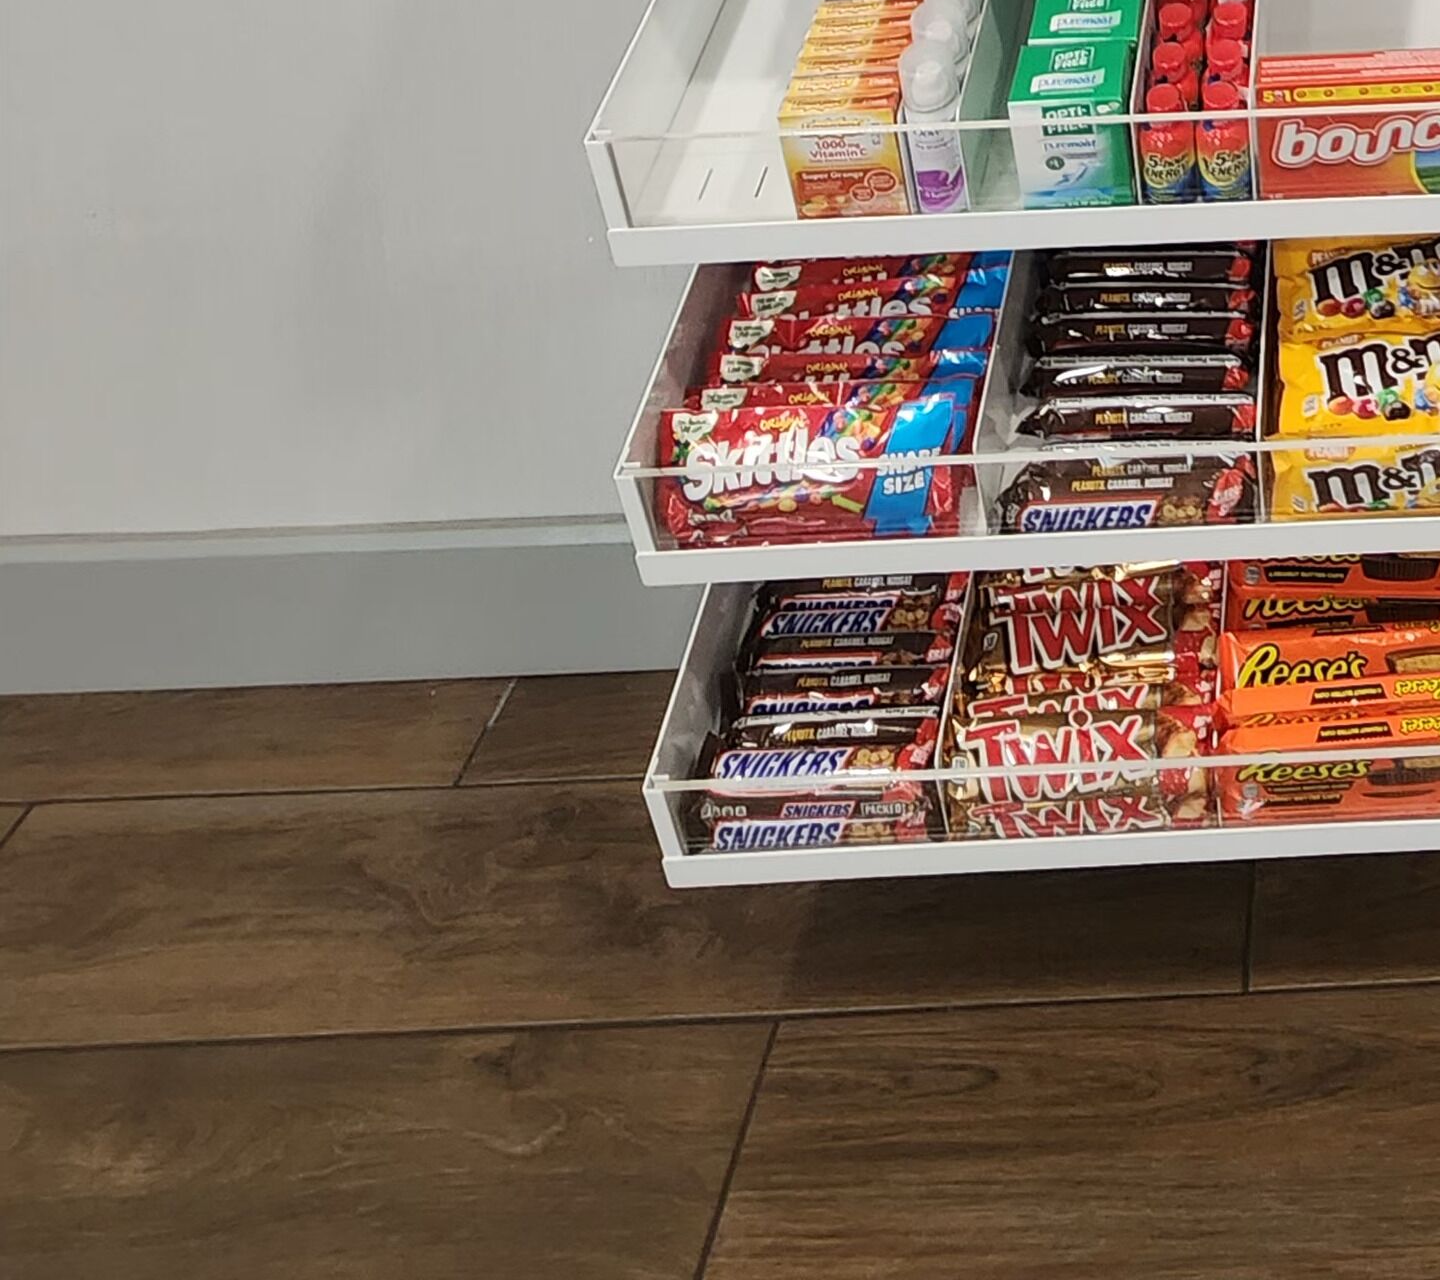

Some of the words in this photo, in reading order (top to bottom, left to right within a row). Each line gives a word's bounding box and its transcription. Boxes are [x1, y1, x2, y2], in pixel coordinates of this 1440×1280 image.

[684, 425, 863, 501] Skittles
[883, 474, 926, 495] SIZE
[1024, 504, 1153, 533] SNICKERS
[717, 748, 849, 778] SNICKERS
